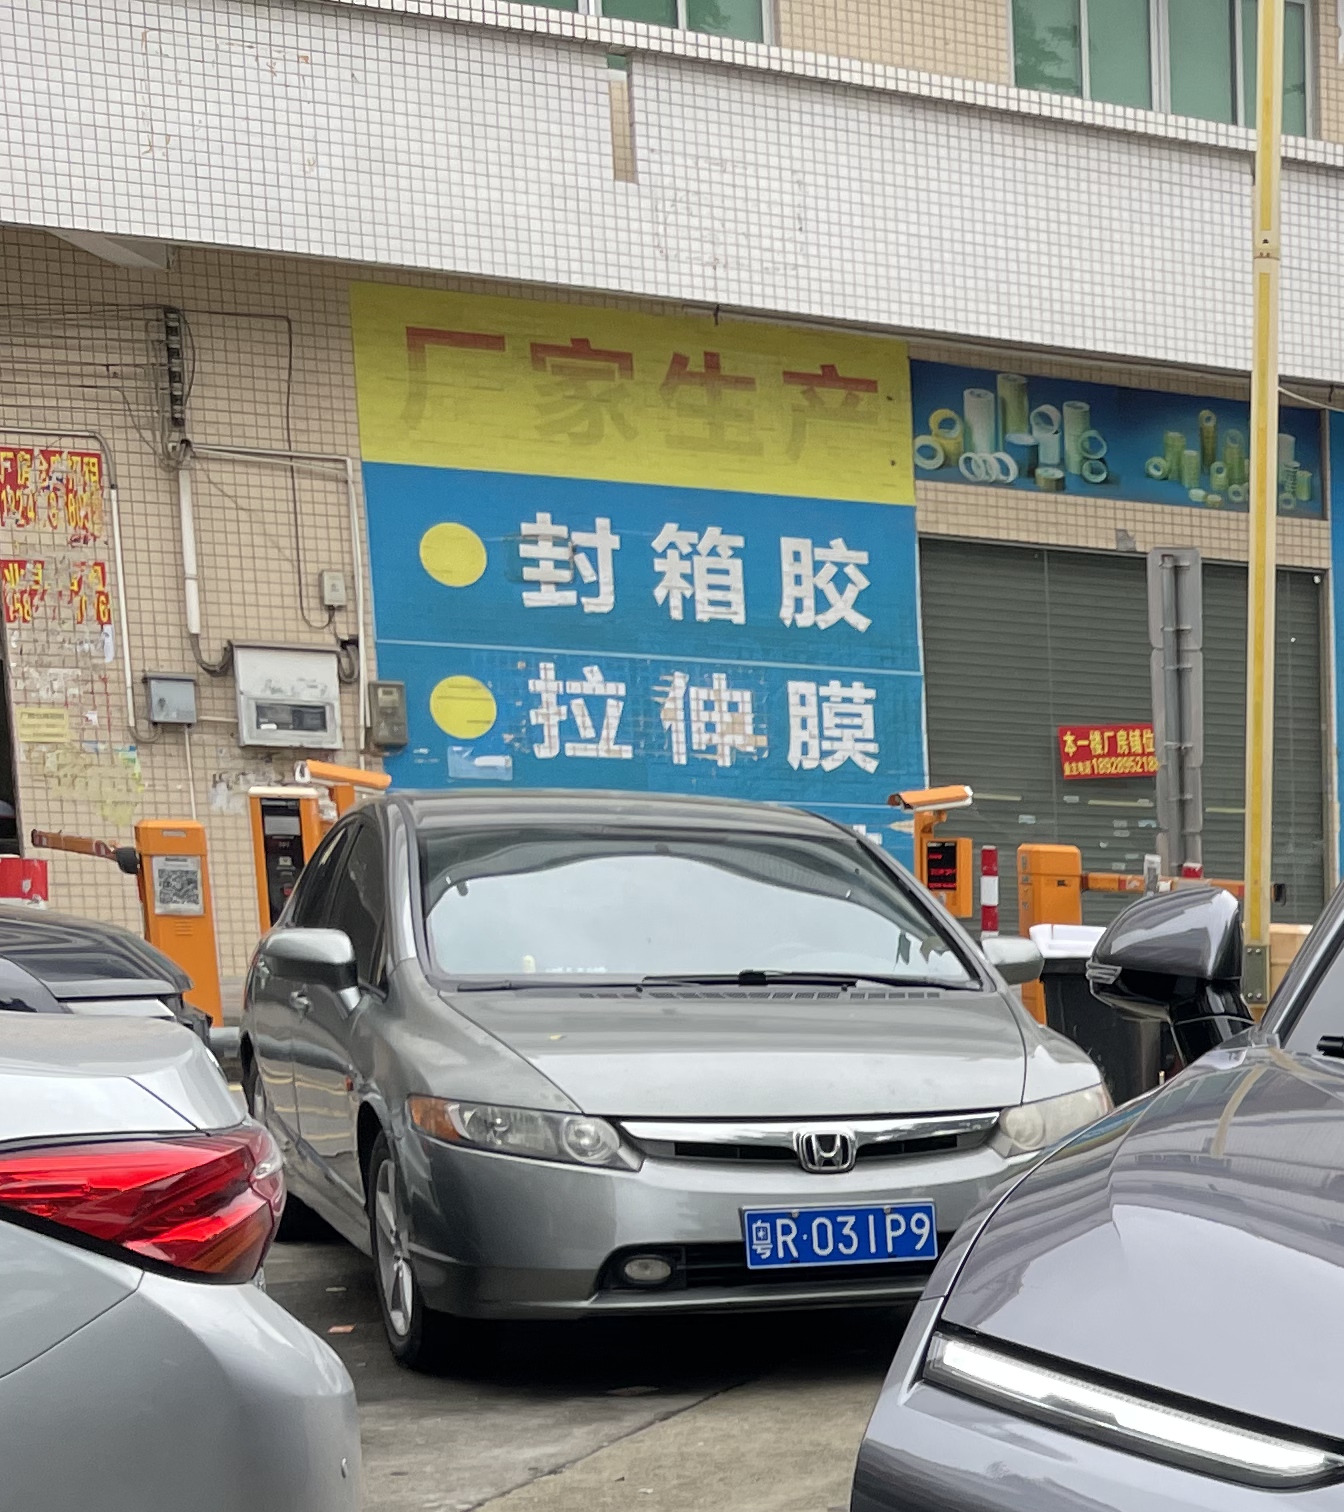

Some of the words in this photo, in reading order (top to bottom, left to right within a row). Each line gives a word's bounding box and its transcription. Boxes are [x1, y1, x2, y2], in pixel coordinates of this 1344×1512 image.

[404, 326, 880, 462] 厂家生产
[520, 512, 873, 633] 封箱胶
[527, 662, 881, 775] 拉伸膜
